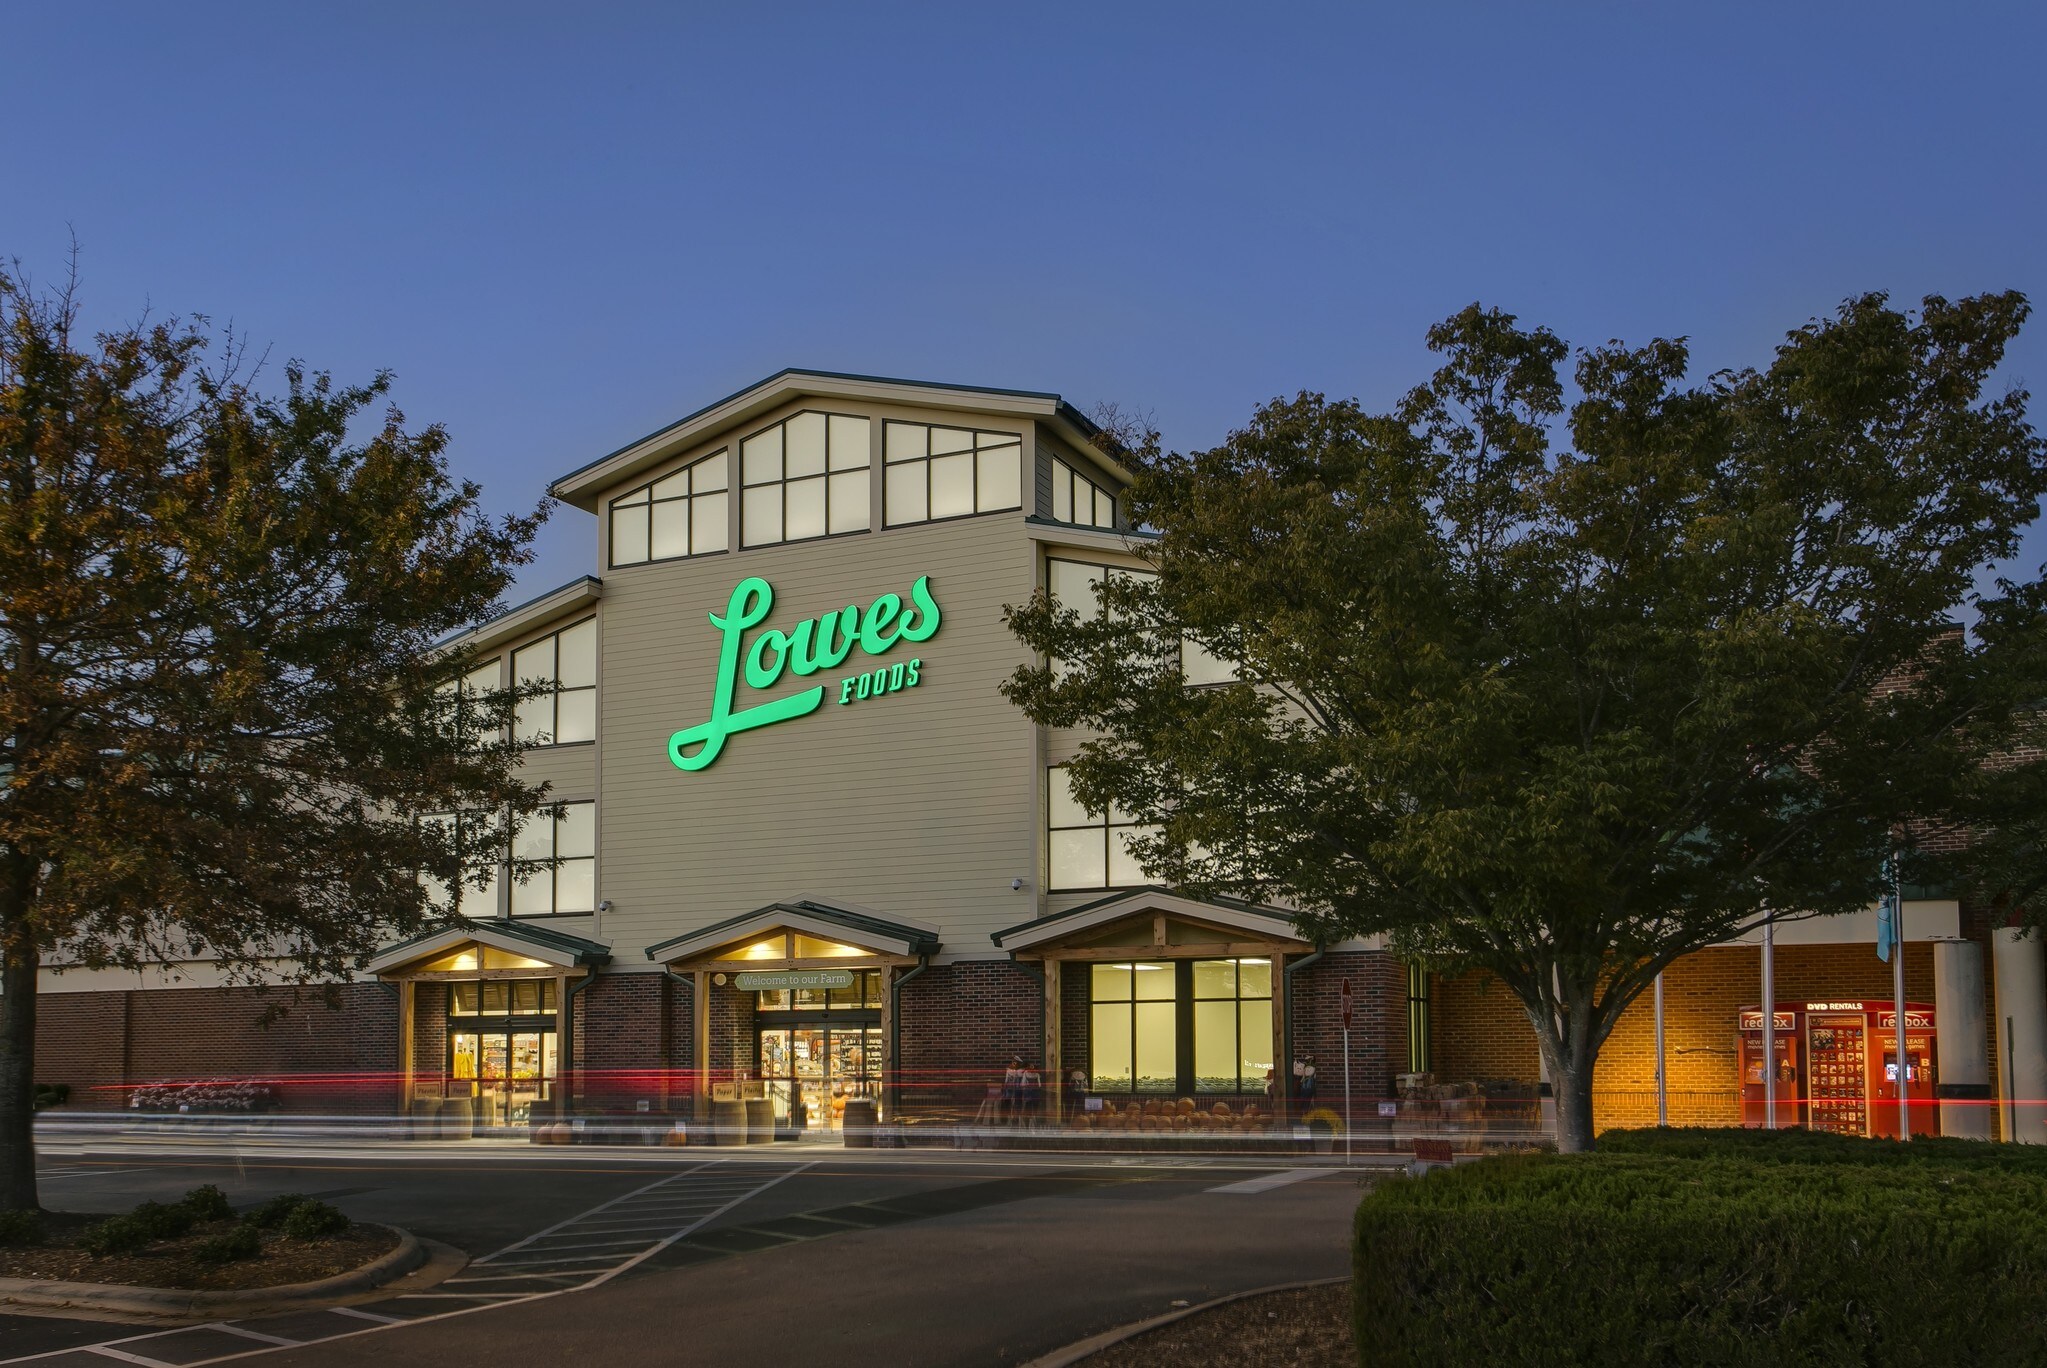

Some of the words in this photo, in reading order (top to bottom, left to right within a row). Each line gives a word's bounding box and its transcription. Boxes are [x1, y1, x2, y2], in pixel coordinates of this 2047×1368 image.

[668, 575, 942, 771] Lowes
[838, 658, 923, 705] FOODS
[743, 975, 787, 986] Welcome
[789, 976, 799, 985] to
[801, 976, 818, 985] our
[820, 973, 846, 984] Farm
[1744, 1017, 1788, 1028] redox
[1882, 1016, 1929, 1027] rebox
[1781, 1059, 1790, 1067] A
[1921, 1058, 1930, 1067] B
